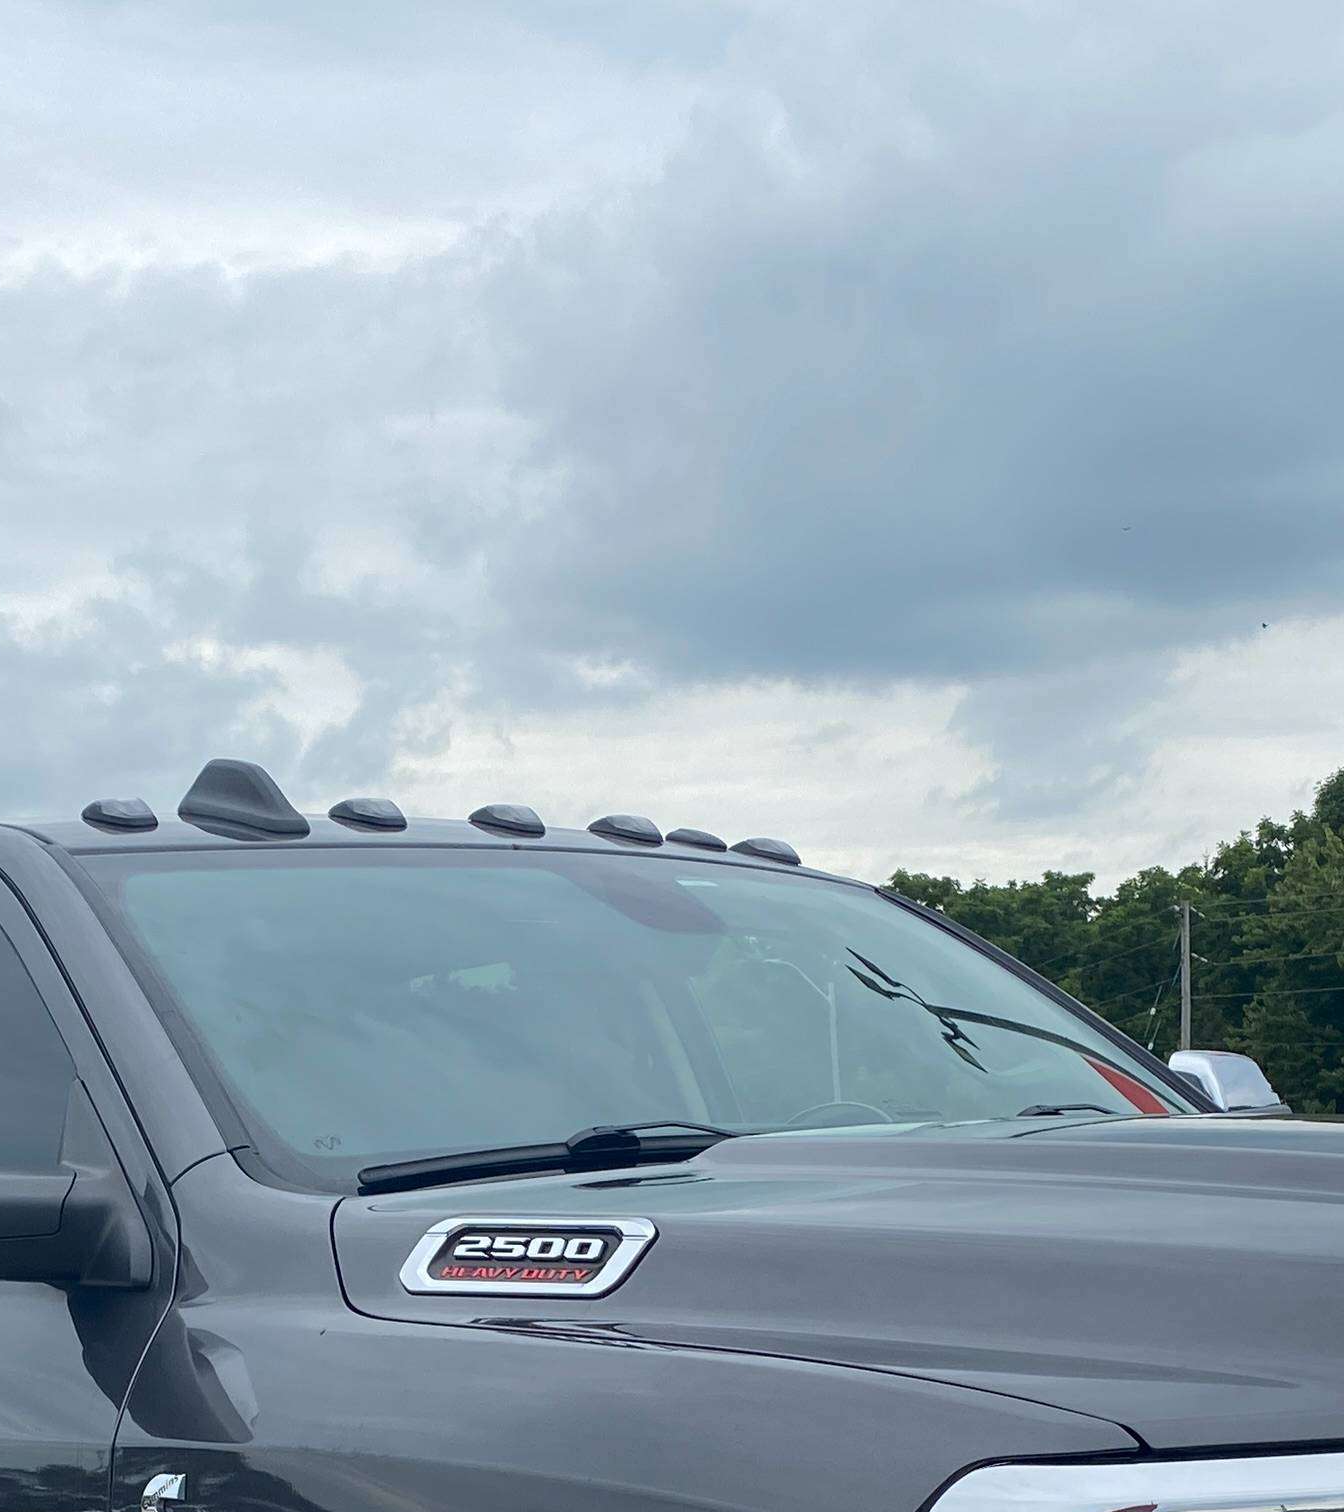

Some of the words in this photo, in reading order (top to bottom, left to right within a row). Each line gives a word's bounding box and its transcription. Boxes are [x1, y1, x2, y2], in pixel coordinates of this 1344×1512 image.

[453, 1236, 605, 1260] 2500
[441, 1266, 518, 1278] HEAVY
[520, 1268, 589, 1280] DUTY
